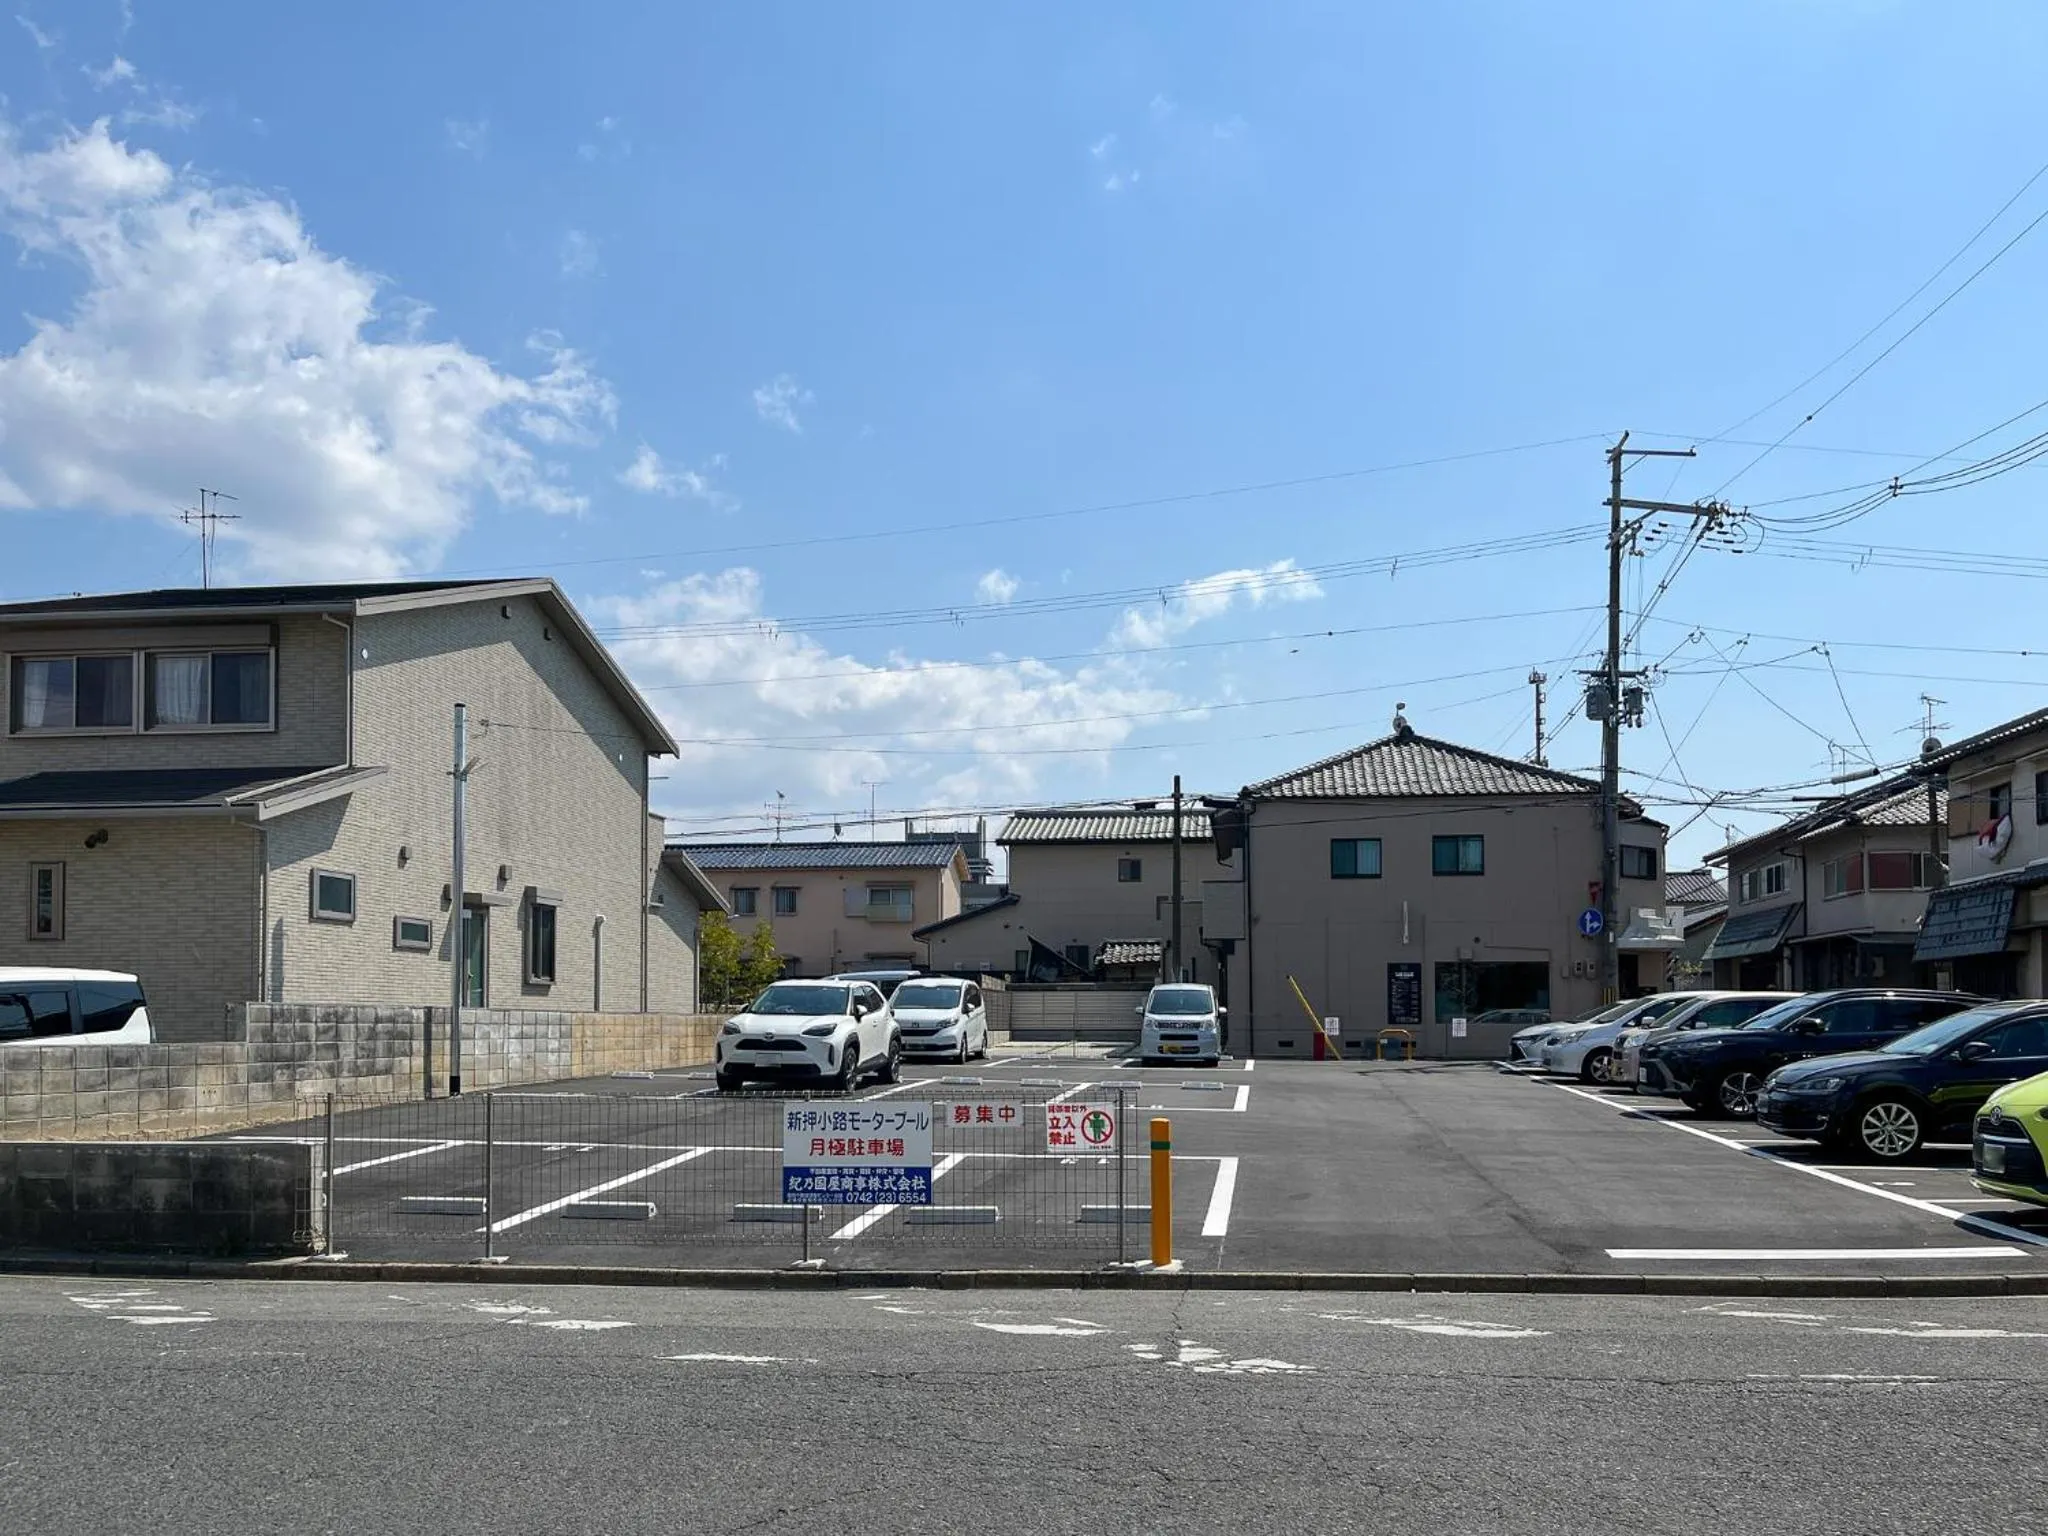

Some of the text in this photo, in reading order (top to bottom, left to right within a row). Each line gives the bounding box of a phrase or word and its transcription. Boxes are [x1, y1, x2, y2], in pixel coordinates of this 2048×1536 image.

[787, 1110, 929, 1131] 新押小路モータープール
[954, 1104, 1015, 1123] 募集中
[1048, 1116, 1076, 1129] 立入
[809, 1138, 905, 1157] 月極駐車場
[1049, 1132, 1076, 1145] 禁止
